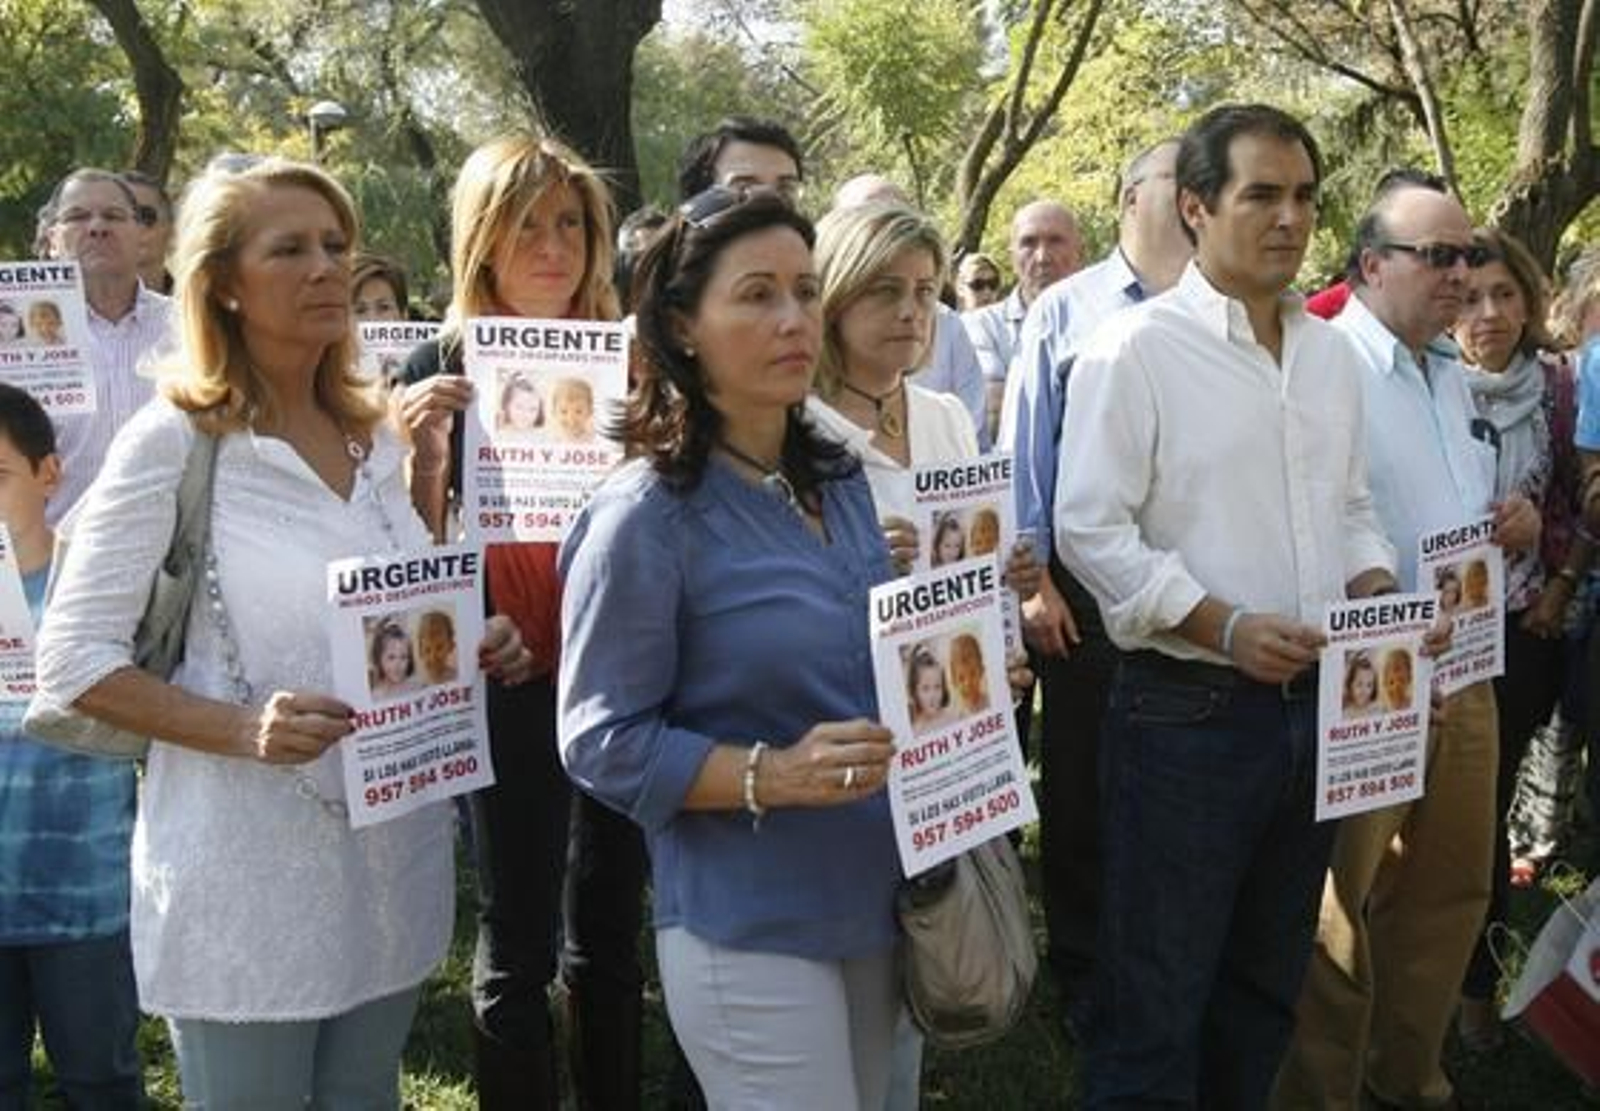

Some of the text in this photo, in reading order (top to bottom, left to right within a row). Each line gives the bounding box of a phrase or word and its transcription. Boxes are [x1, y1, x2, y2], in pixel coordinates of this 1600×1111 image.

[364, 326, 439, 340] URGENT
[475, 325, 622, 351] URGENTE
[478, 447, 609, 465] RUTH Y JOSE
[915, 458, 1011, 492] URGENTE
[478, 513, 514, 528] 957
[524, 513, 561, 528] 594
[1422, 520, 1496, 553] URGENT
[338, 553, 477, 594] URGENTE
[878, 565, 994, 623] URGENTE
[1329, 600, 1435, 631] URGENTE
[355, 686, 472, 728] RUTH Y JOSE
[901, 713, 1005, 768] RUTH Y JOSE
[1328, 712, 1419, 742] RUTH Y JOSE
[364, 755, 478, 808] 957 594 500
[1326, 771, 1416, 805] 957 594 500
[912, 789, 1020, 852] 957 594 500
